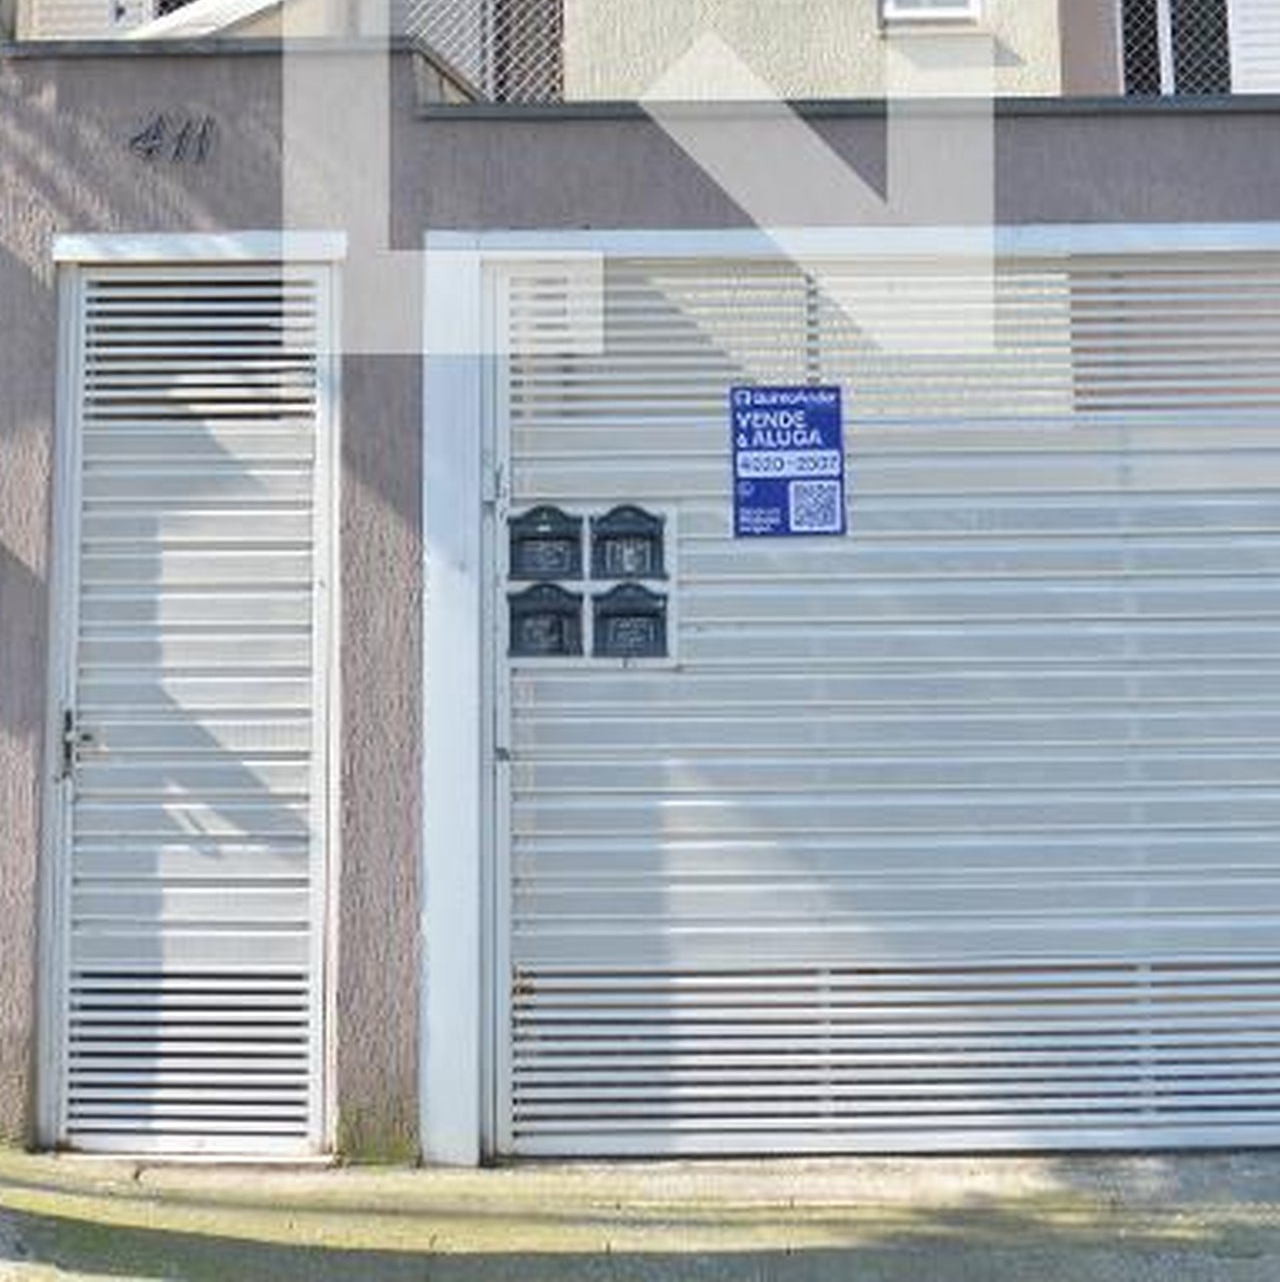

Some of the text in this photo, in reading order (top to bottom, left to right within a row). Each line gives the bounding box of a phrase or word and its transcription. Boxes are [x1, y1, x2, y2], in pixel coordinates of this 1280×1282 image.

[128, 114, 216, 164] 411
[736, 410, 807, 429] VENDE
[752, 429, 824, 448] ALUGA
